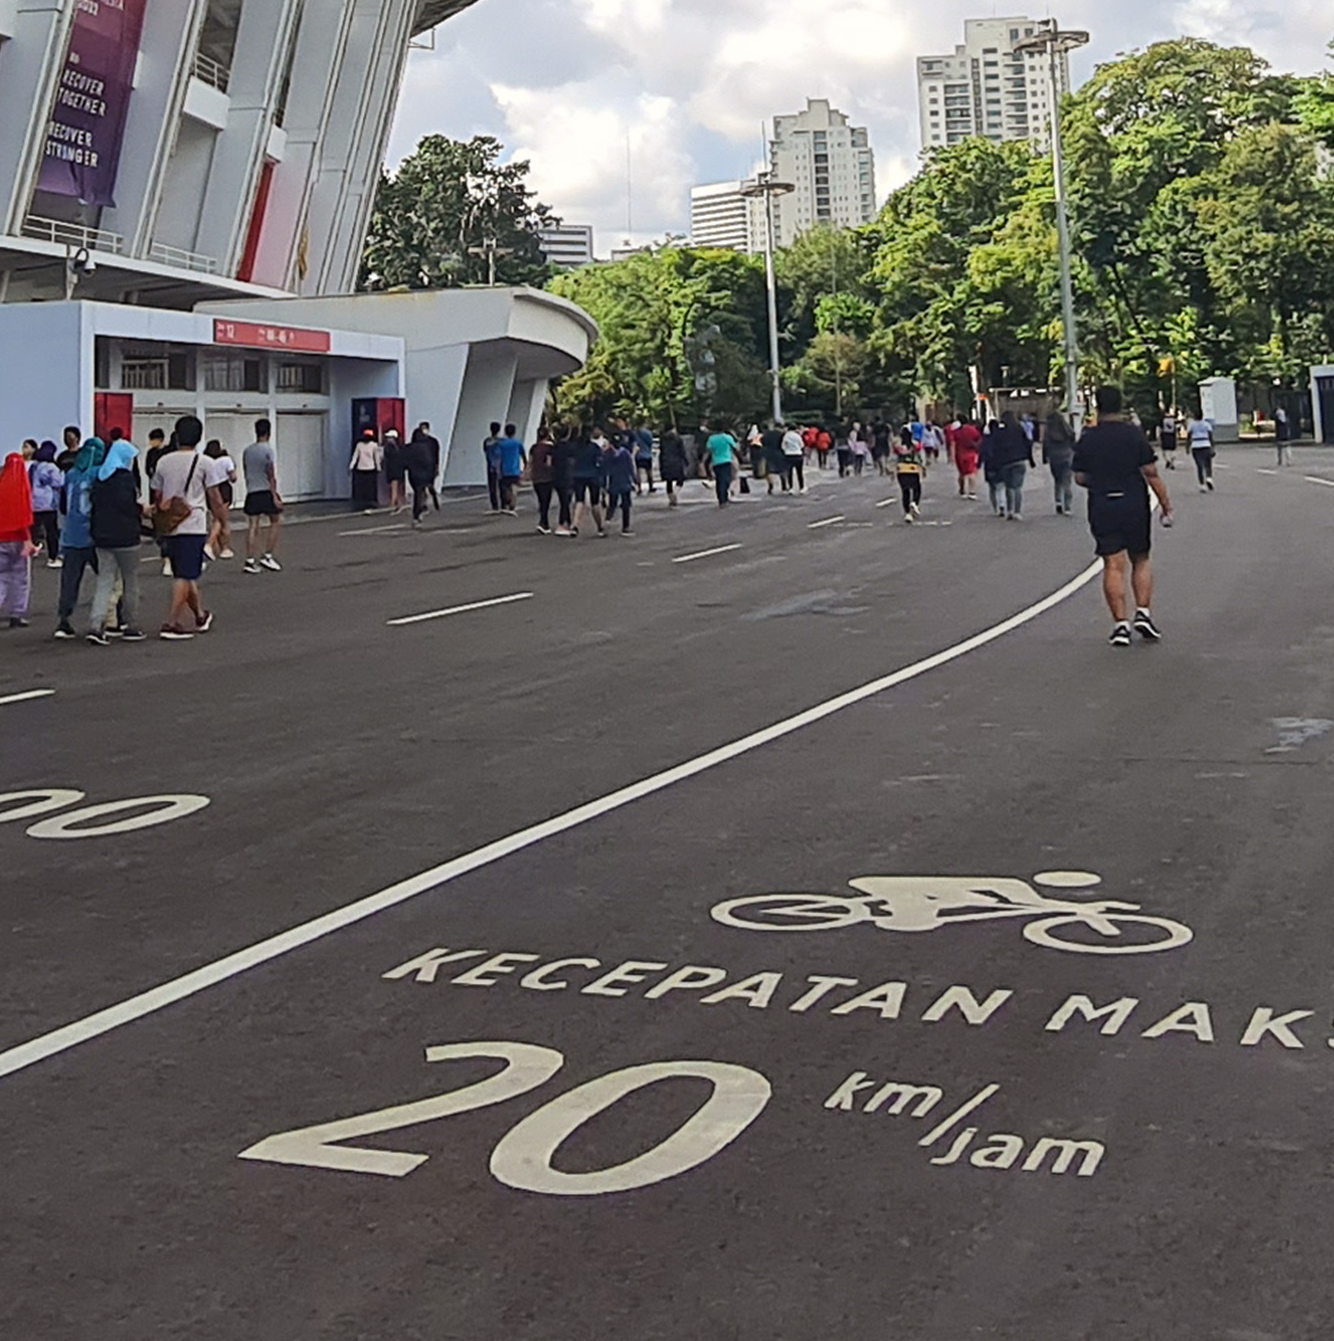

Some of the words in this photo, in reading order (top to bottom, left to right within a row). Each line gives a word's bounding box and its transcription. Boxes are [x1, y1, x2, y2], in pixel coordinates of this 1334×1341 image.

[57, 87, 107, 117] TOGETHER
[62, 69, 105, 96] RECOVER
[381, 947, 1012, 1025] KECEPATAN
[237, 1040, 773, 1196] 20
[823, 1071, 1106, 1177] km/jam
